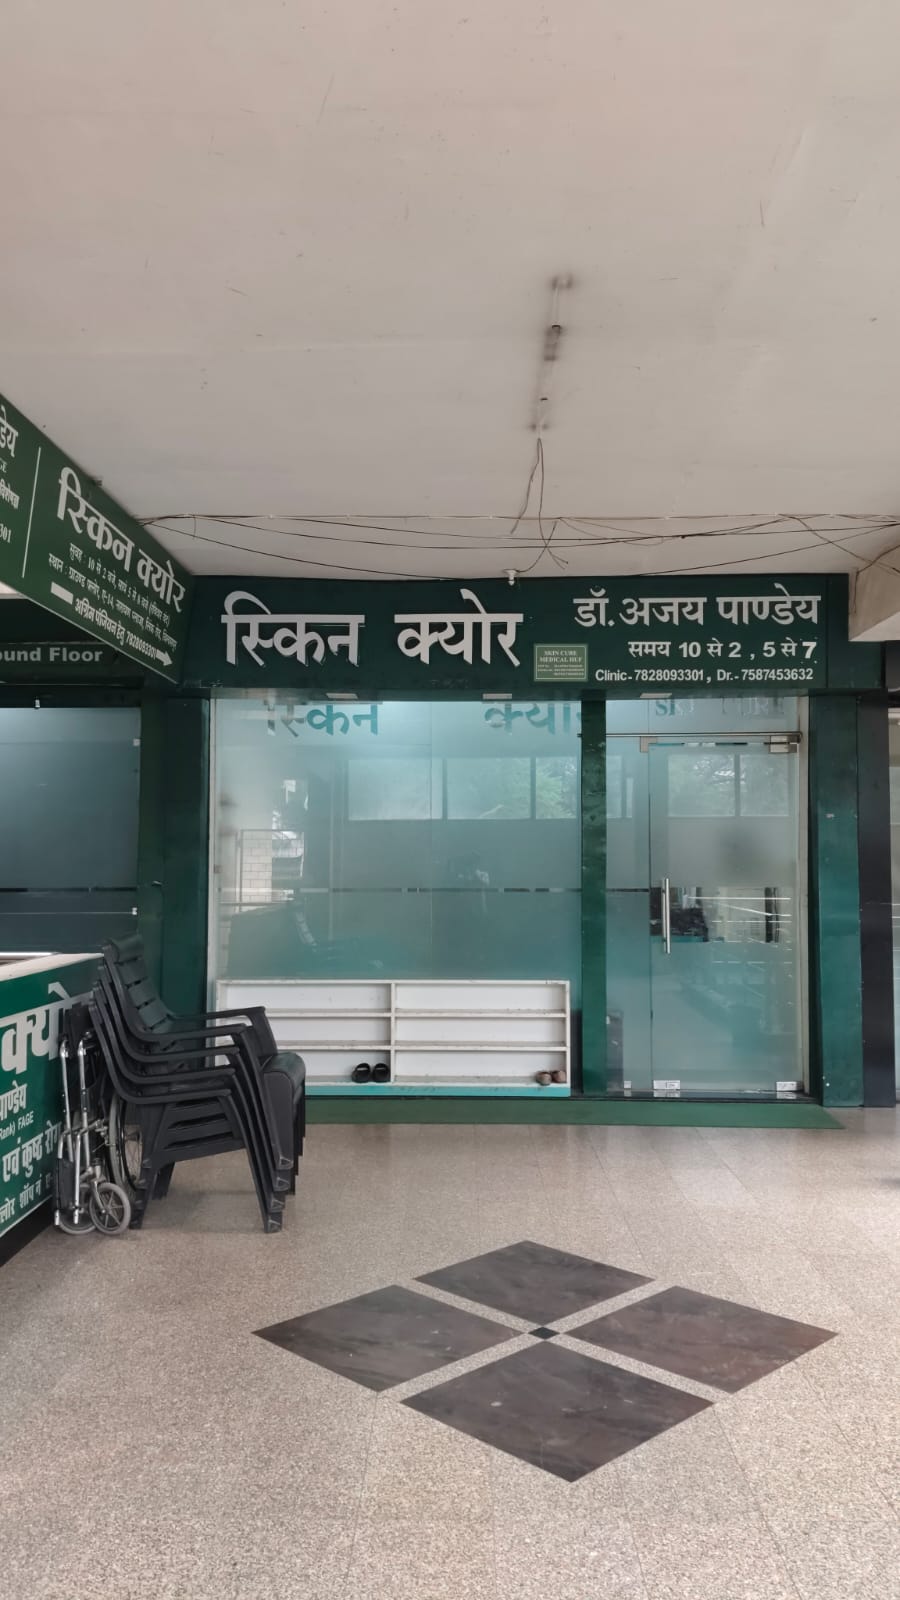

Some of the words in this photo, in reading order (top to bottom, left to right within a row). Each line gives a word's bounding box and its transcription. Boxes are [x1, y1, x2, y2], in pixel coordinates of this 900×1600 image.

[57, 466, 135, 572] स्किन
[137, 548, 187, 613] क्योर
[75, 598, 95, 622] अग्रिम
[716, 583, 822, 626] पाण्डेय
[220, 590, 365, 668] स्किन
[394, 588, 524, 668] क्योर
[0, 647, 41, 662] und
[50, 647, 104, 662] Floor
[628, 640, 672, 658] समय
[678, 641, 702, 659] 10
[706, 637, 724, 659] से
[728, 642, 742, 658] 2
[762, 642, 776, 658] 5
[780, 637, 798, 659] से
[802, 641, 818, 660] 7
[17, 1110, 34, 1131] FAGE
[2, 1136, 22, 1183] एवं
[19, 1182, 35, 1209] शॉप
